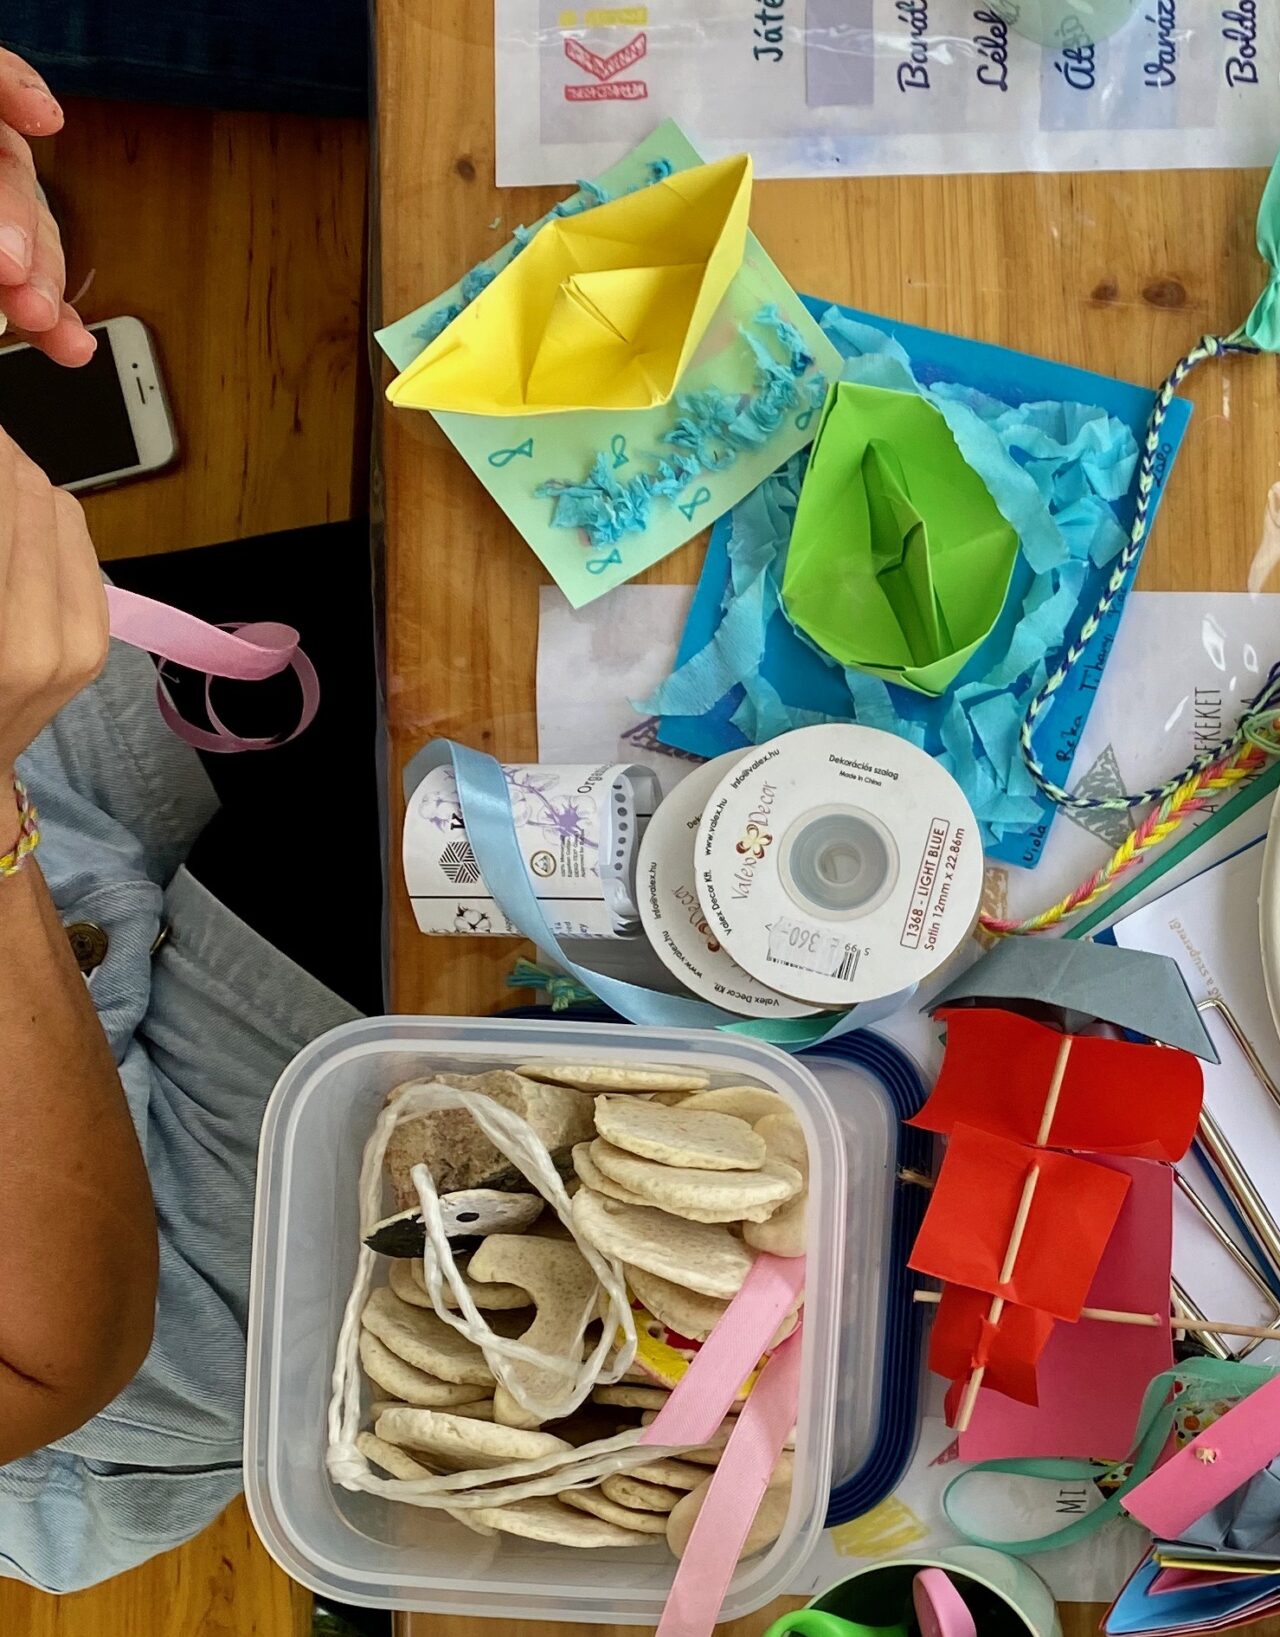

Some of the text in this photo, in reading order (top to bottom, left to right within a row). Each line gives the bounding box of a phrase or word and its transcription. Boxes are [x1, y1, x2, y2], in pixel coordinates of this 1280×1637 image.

[1054, 42, 1095, 90] Át
[906, 908, 924, 938] 1368
[917, 861, 937, 897] LIGHT
[928, 827, 945, 858] BLUE
[924, 923, 940, 950] Satin
[932, 882, 952, 919] 12mm
[1055, 1489, 1087, 1513] MI
